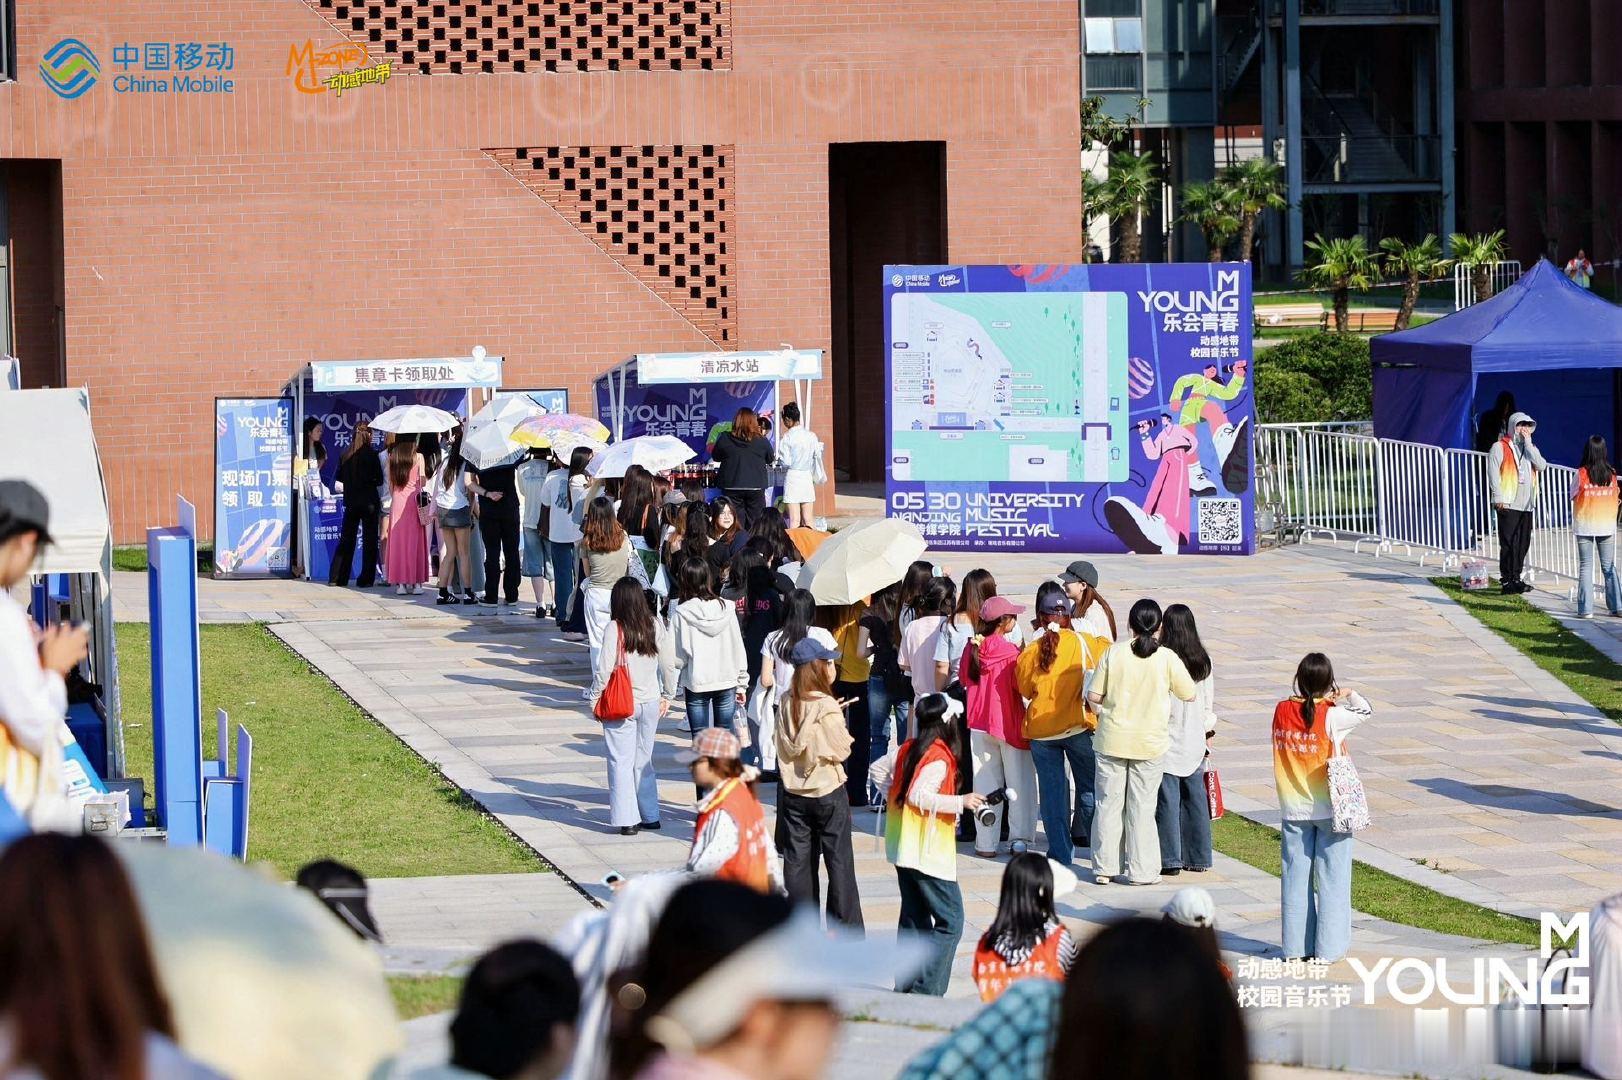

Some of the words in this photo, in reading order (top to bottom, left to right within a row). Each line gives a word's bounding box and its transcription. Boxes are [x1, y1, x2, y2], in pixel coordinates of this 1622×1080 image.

[1218, 270, 1239, 295] M
[1137, 291, 1239, 312] YOUNG
[1163, 312, 1239, 333] 乐会青春
[1200, 335, 1239, 346] 动感地带
[1190, 347, 1239, 358] 校园音乐节
[355, 365, 455, 383] 集章卡领取处
[701, 358, 760, 374] 清凉水站
[624, 405, 707, 422] YOUNG
[238, 417, 288, 428] YOUNG
[646, 421, 707, 437] 乐会青春
[222, 470, 288, 487] 现场门票
[892, 492, 924, 509] 05
[929, 492, 961, 509] 30
[966, 493, 1084, 508] UNIVERSITY
[966, 508, 1027, 522] MUSIC
[966, 523, 1059, 537] FESTIVAL
